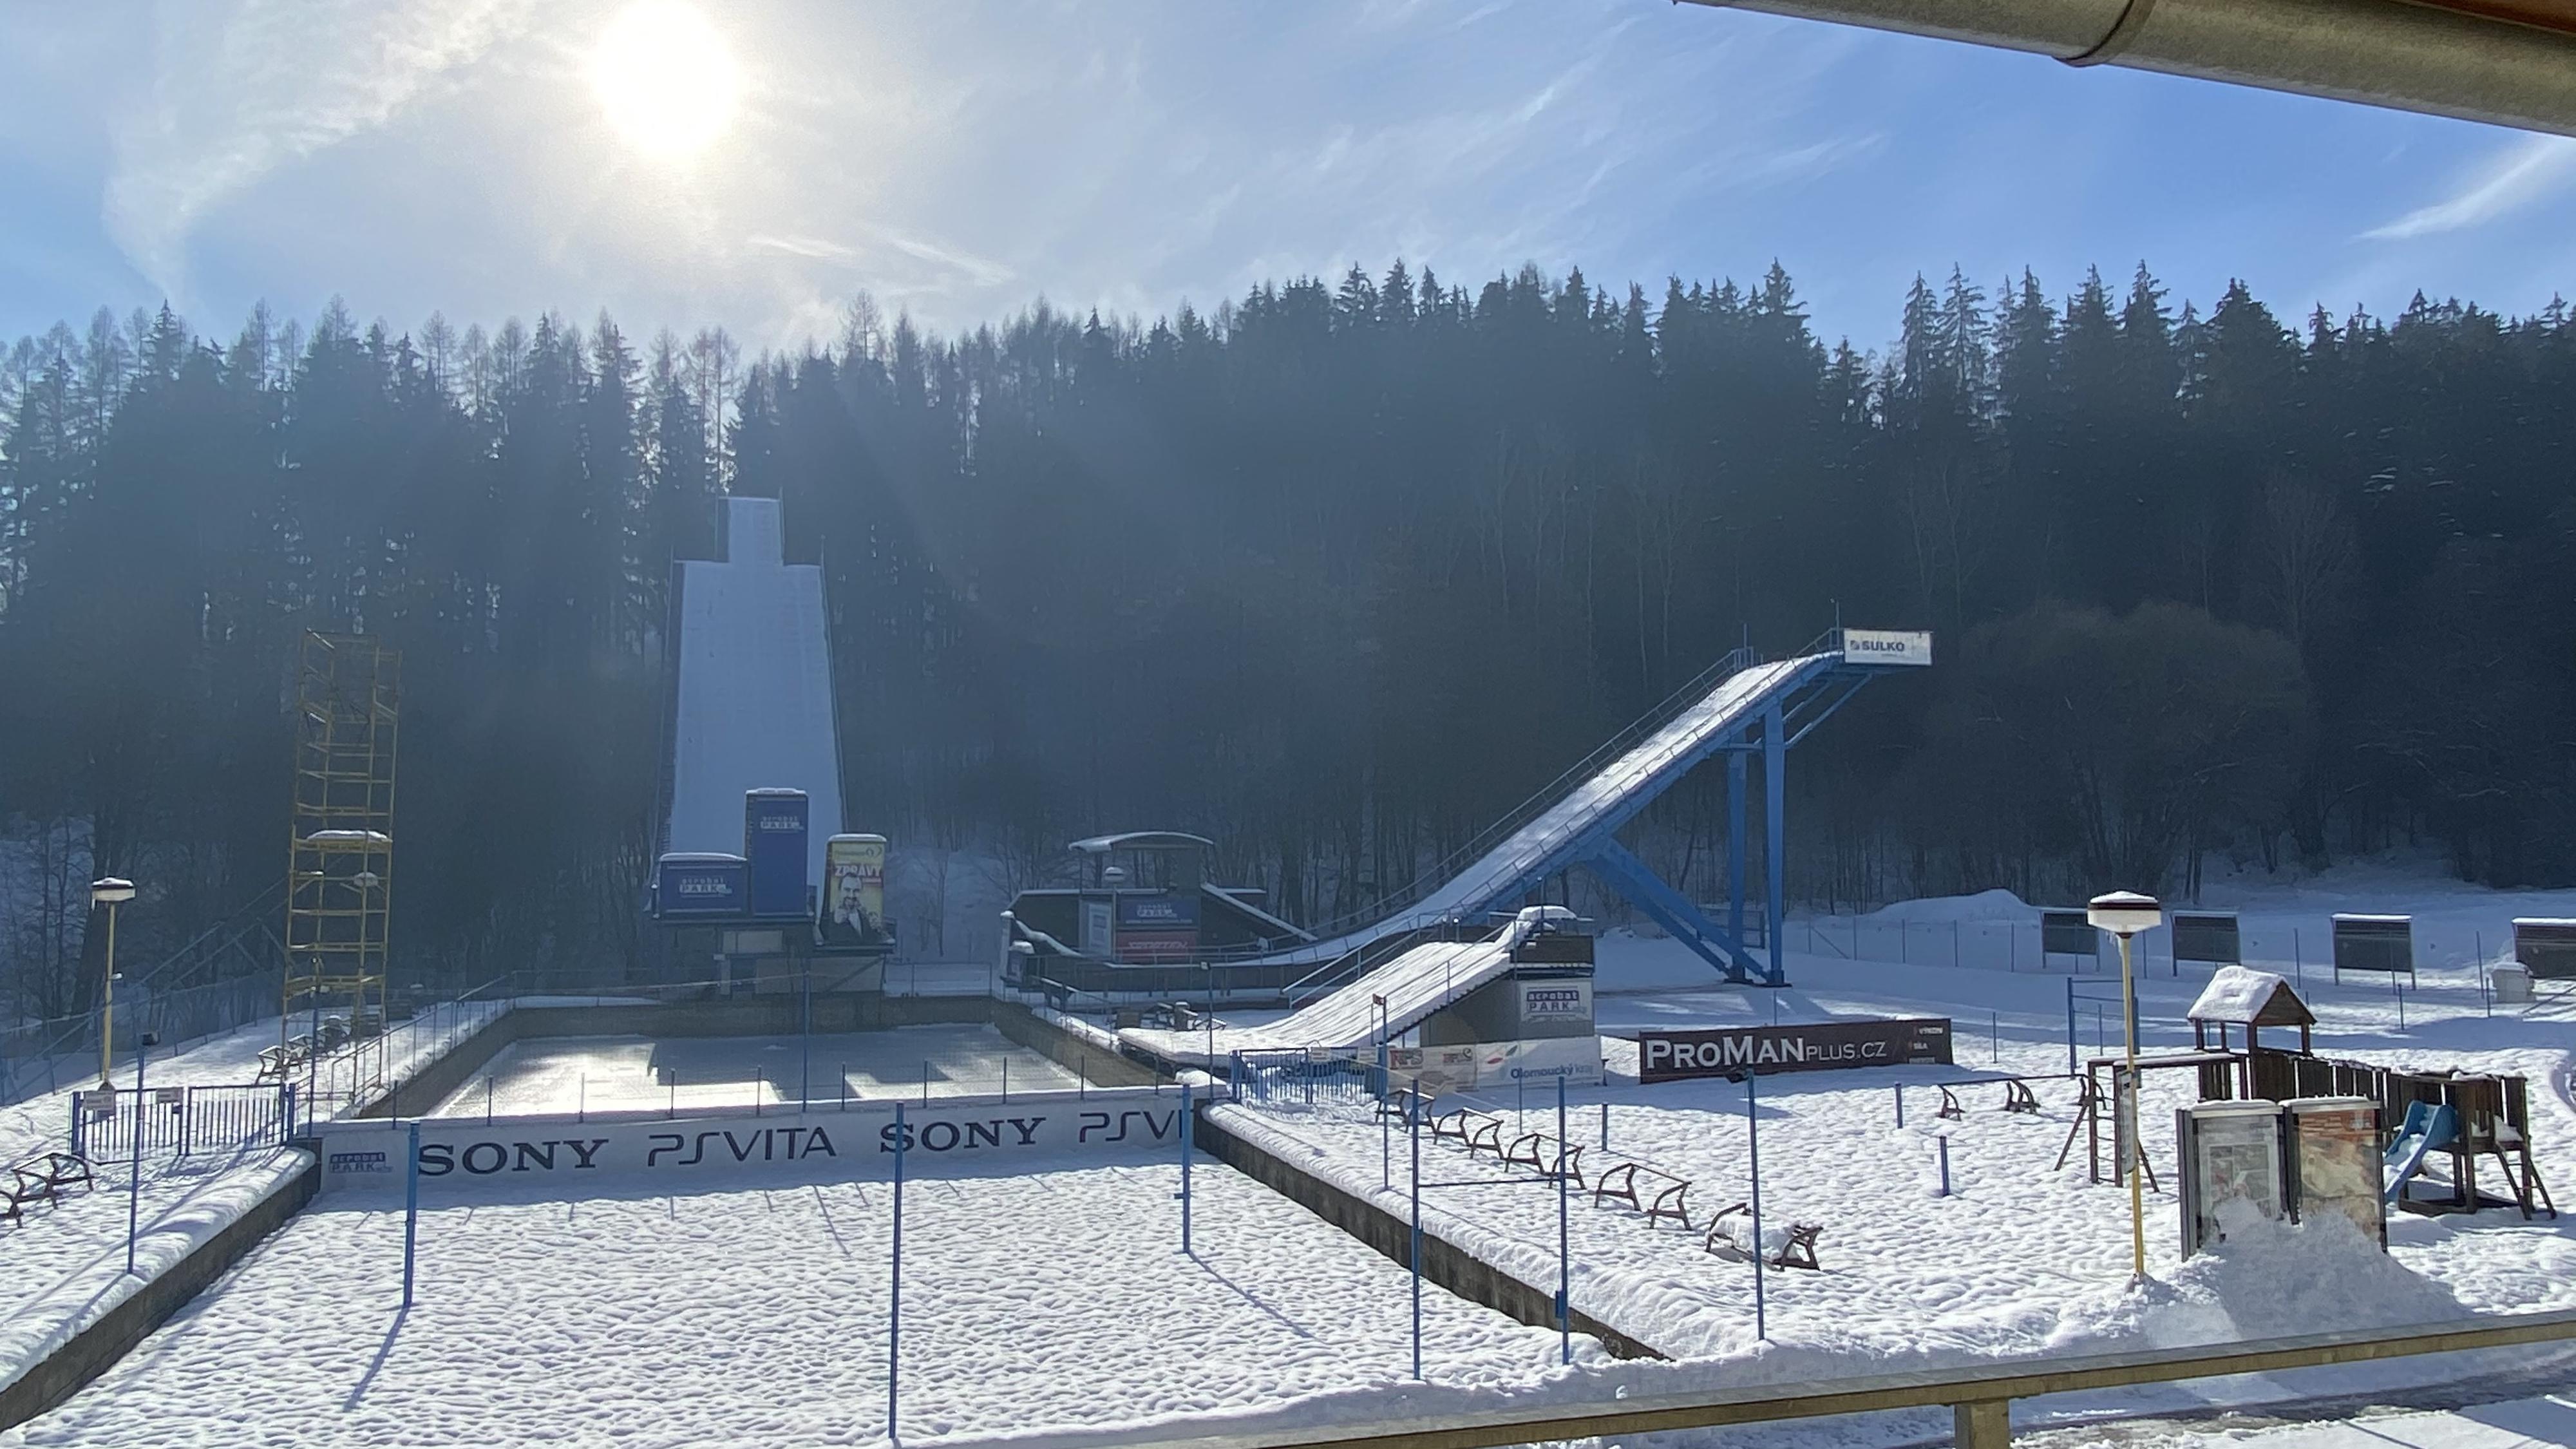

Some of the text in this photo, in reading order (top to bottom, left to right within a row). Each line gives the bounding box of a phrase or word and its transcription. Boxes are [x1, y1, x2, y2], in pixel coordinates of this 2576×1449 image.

[1862, 641, 1904, 652] SULKO
[1528, 992, 1577, 1000] acrobat
[1530, 1002, 1569, 1012] PARK
[1511, 1064, 1573, 1079] Olomoucký
[418, 1139, 609, 1176] SONY
[880, 1117, 1046, 1153] SONY
